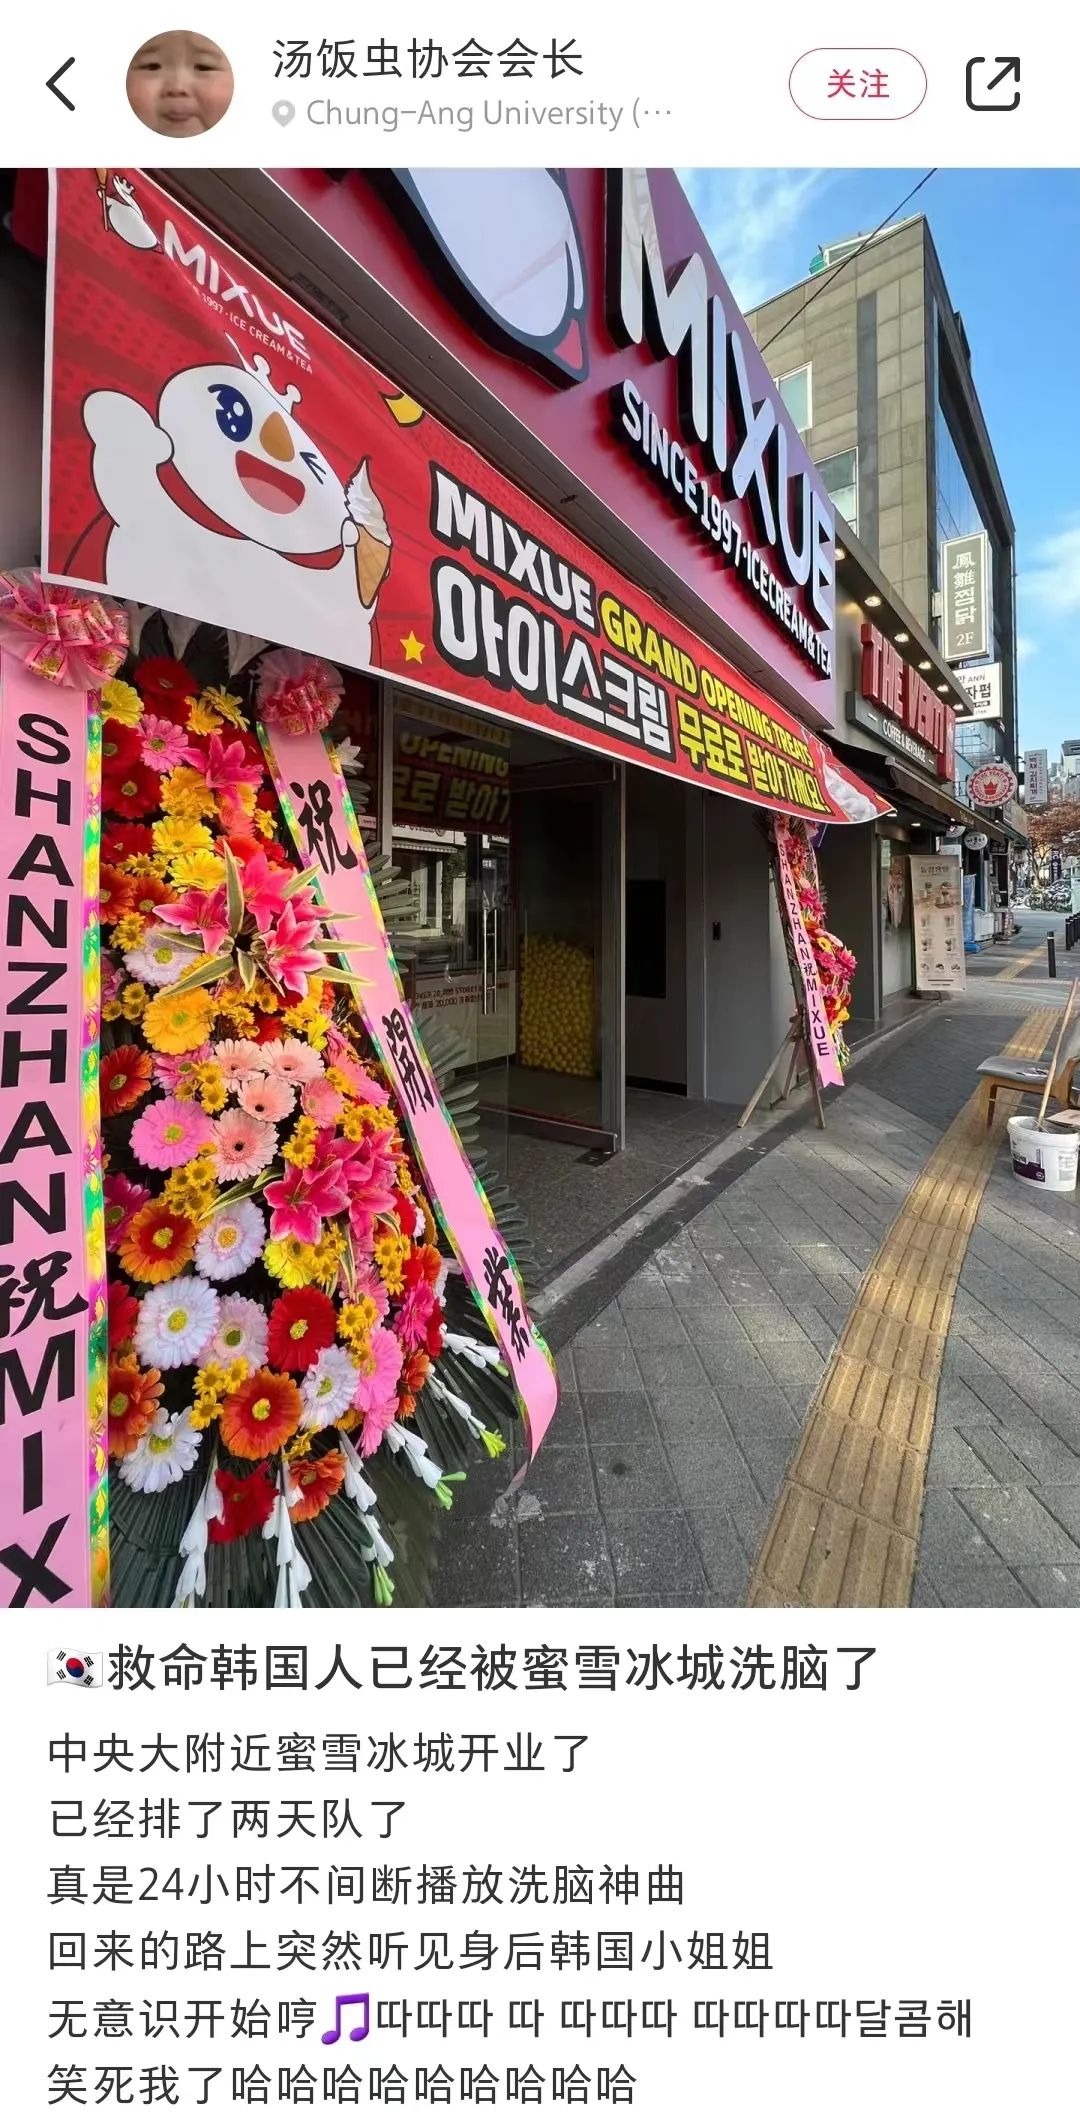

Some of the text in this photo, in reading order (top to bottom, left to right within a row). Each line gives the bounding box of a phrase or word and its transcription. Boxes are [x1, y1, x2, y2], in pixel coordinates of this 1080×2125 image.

[163, 219, 311, 361] MIXUE
[619, 168, 834, 632] MIXUE
[434, 469, 815, 769] MIXUE GRAND OPENING TREATS
[437, 564, 672, 754] 아이스크림
[676, 699, 749, 784] 무료로
[745, 738, 832, 813] 받아가세요!
[863, 623, 904, 720] THE
[955, 631, 975, 647] 2F
[882, 718, 901, 744] COFFEE
